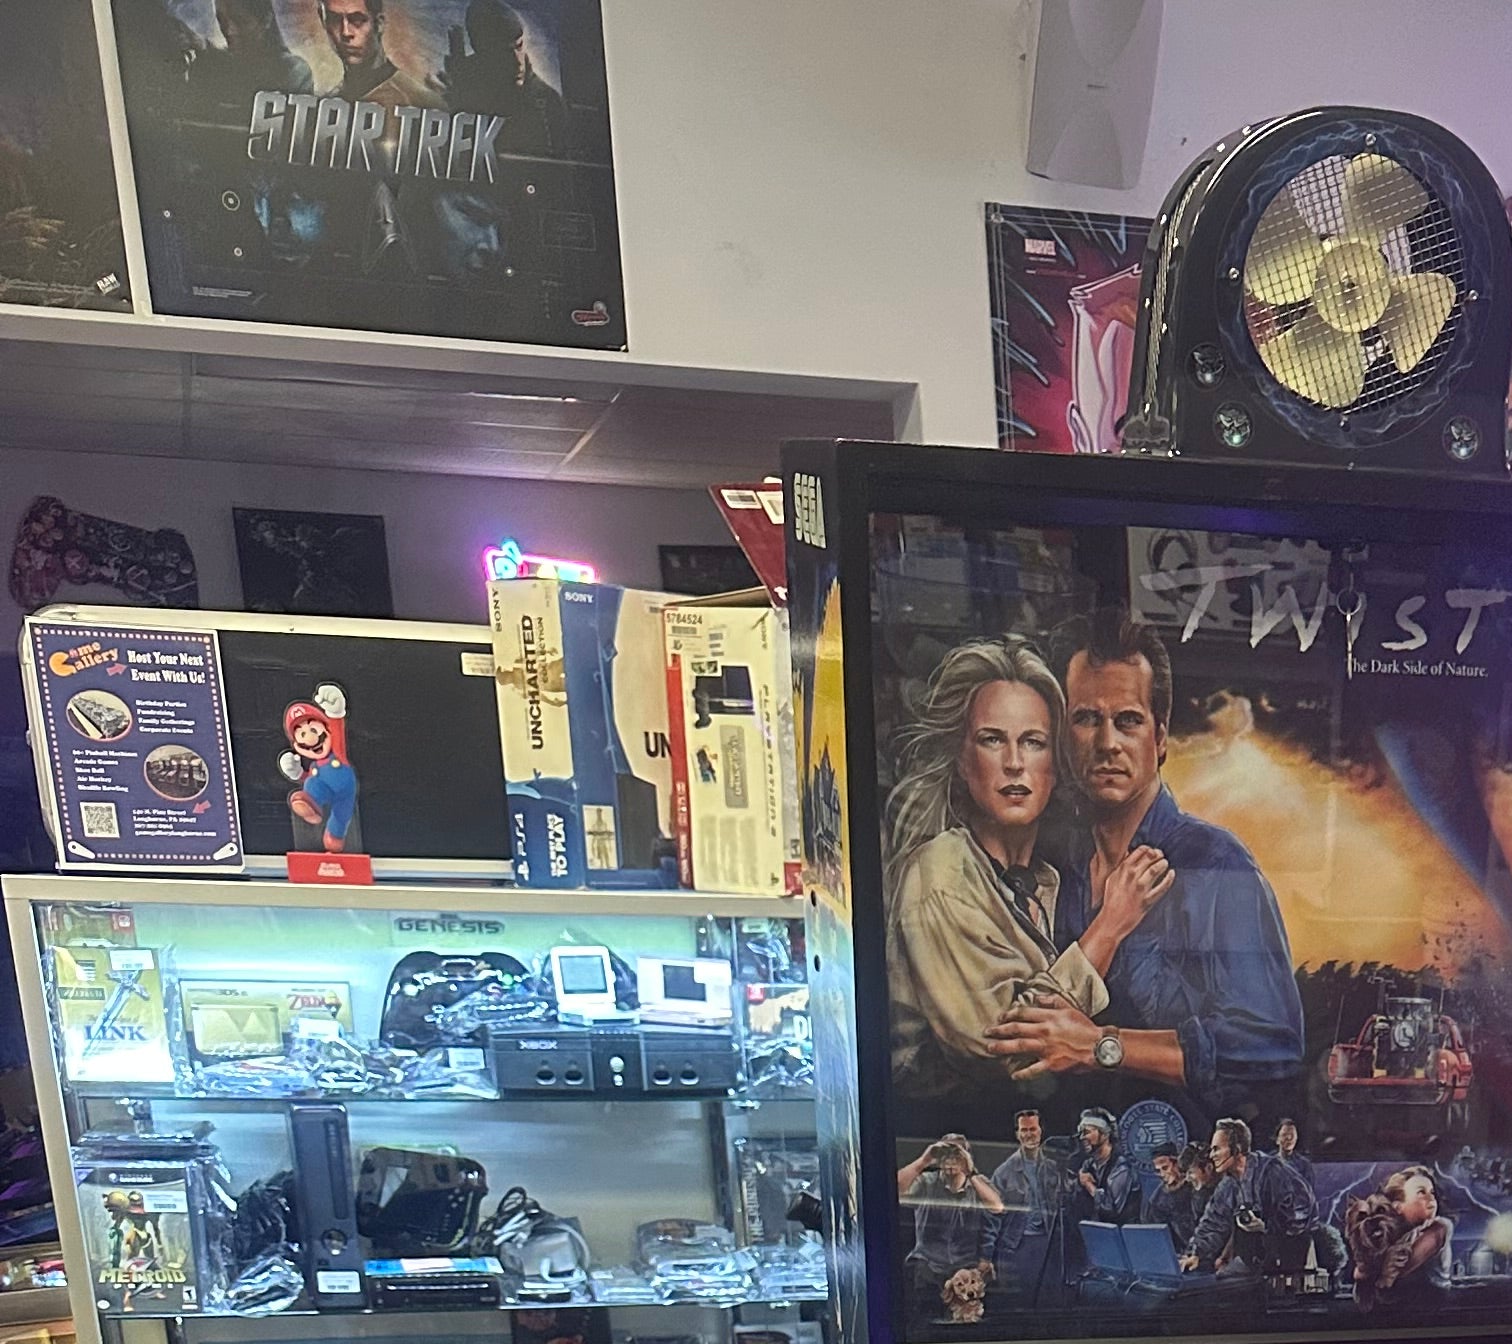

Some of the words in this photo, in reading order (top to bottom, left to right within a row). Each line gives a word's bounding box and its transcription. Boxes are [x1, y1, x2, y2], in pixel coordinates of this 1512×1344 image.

[247, 90, 387, 172] STAR
[393, 104, 506, 184] TREK
[793, 472, 828, 550] SEGA
[564, 590, 595, 604] SONY
[666, 612, 703, 626] 5784524
[127, 650, 152, 664] Host
[153, 651, 177, 665] Your
[179, 652, 204, 667] Next
[1371, 659, 1400, 674] Dark
[1402, 660, 1428, 676] Side
[1430, 660, 1445, 676] of
[131, 669, 161, 682] Event
[162, 669, 188, 683] With
[189, 671, 206, 684] Us!
[520, 614, 545, 750] UNCHARTED
[396, 918, 503, 935] GENESIS
[519, 1039, 559, 1051] XBOX
[98, 1268, 188, 1284] METROID
